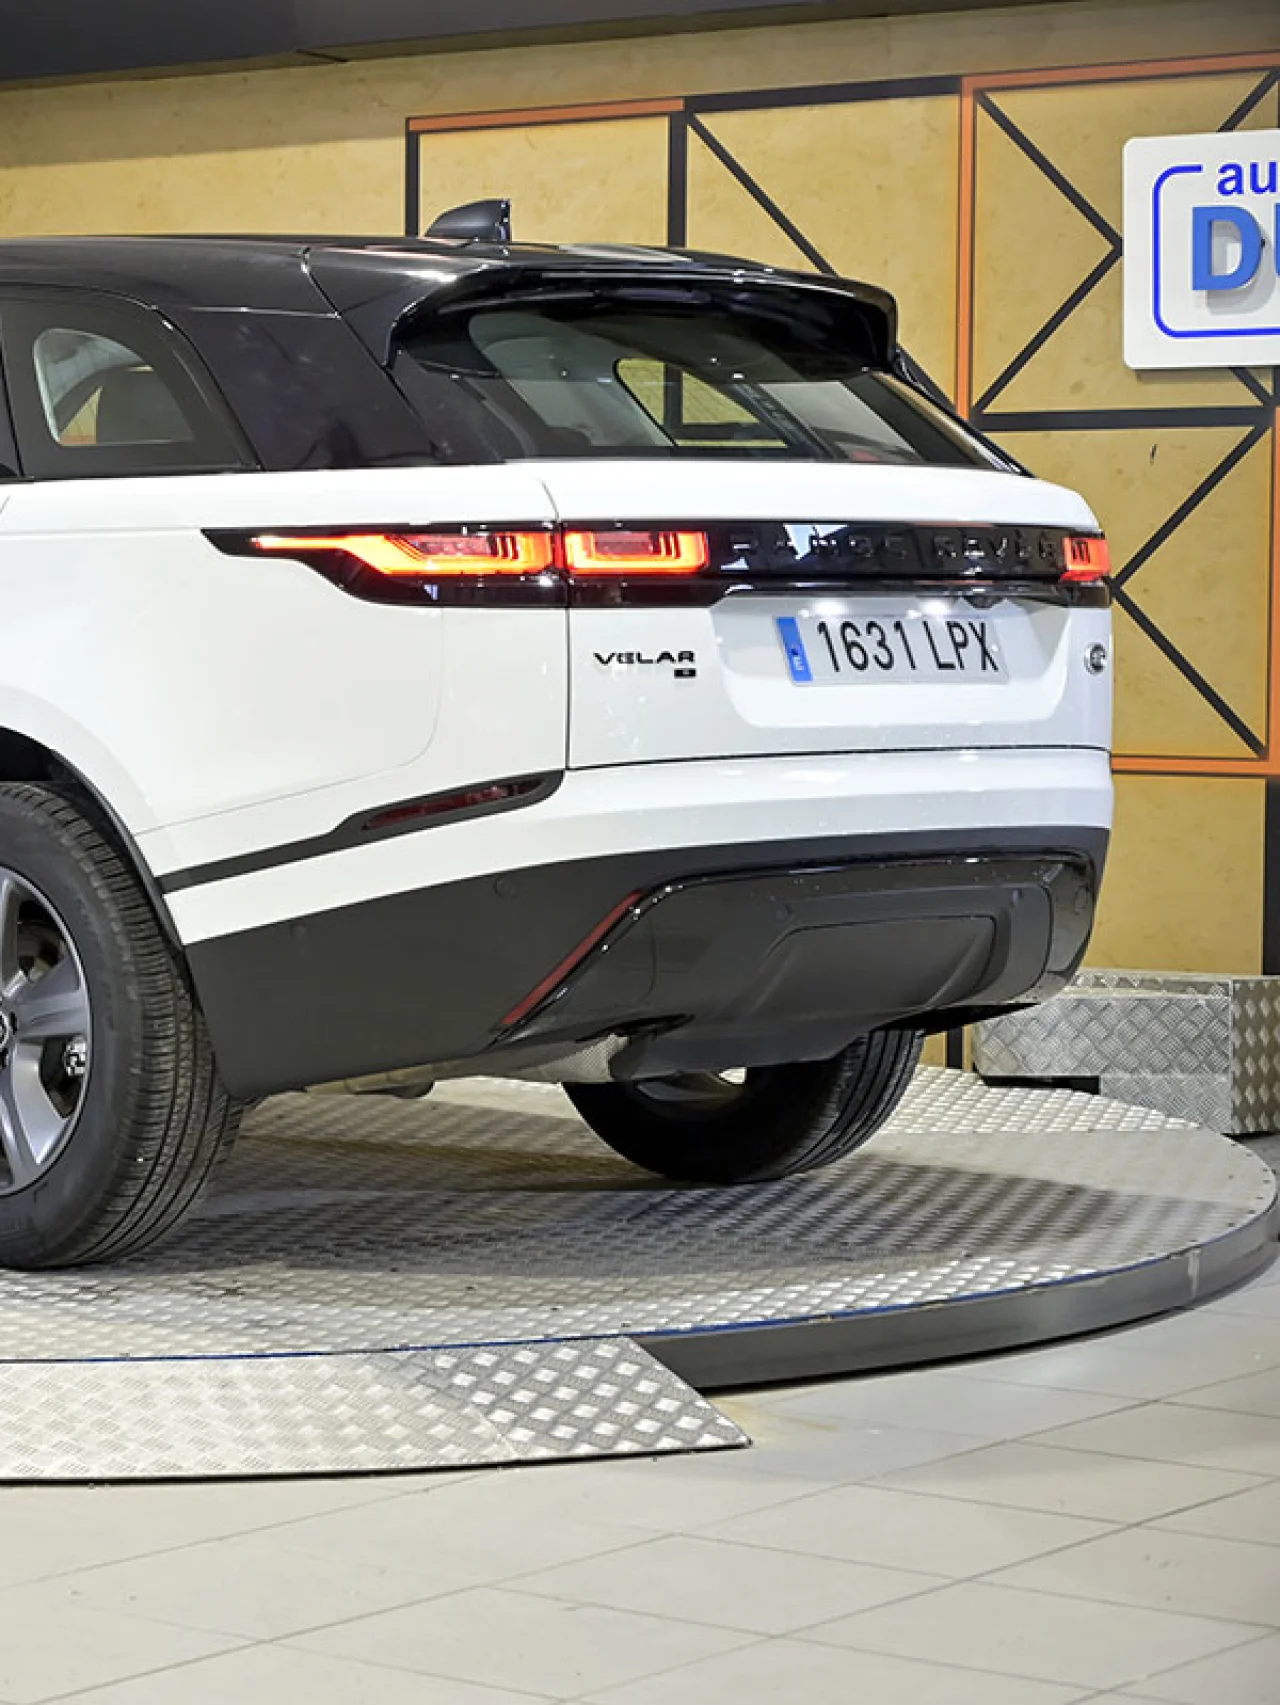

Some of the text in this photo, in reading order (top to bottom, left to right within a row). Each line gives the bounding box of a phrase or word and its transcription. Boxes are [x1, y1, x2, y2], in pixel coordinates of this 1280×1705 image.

[1192, 203, 1280, 291] D
[593, 651, 695, 665] VELAR
[792, 620, 999, 673] E 1631 LPX
